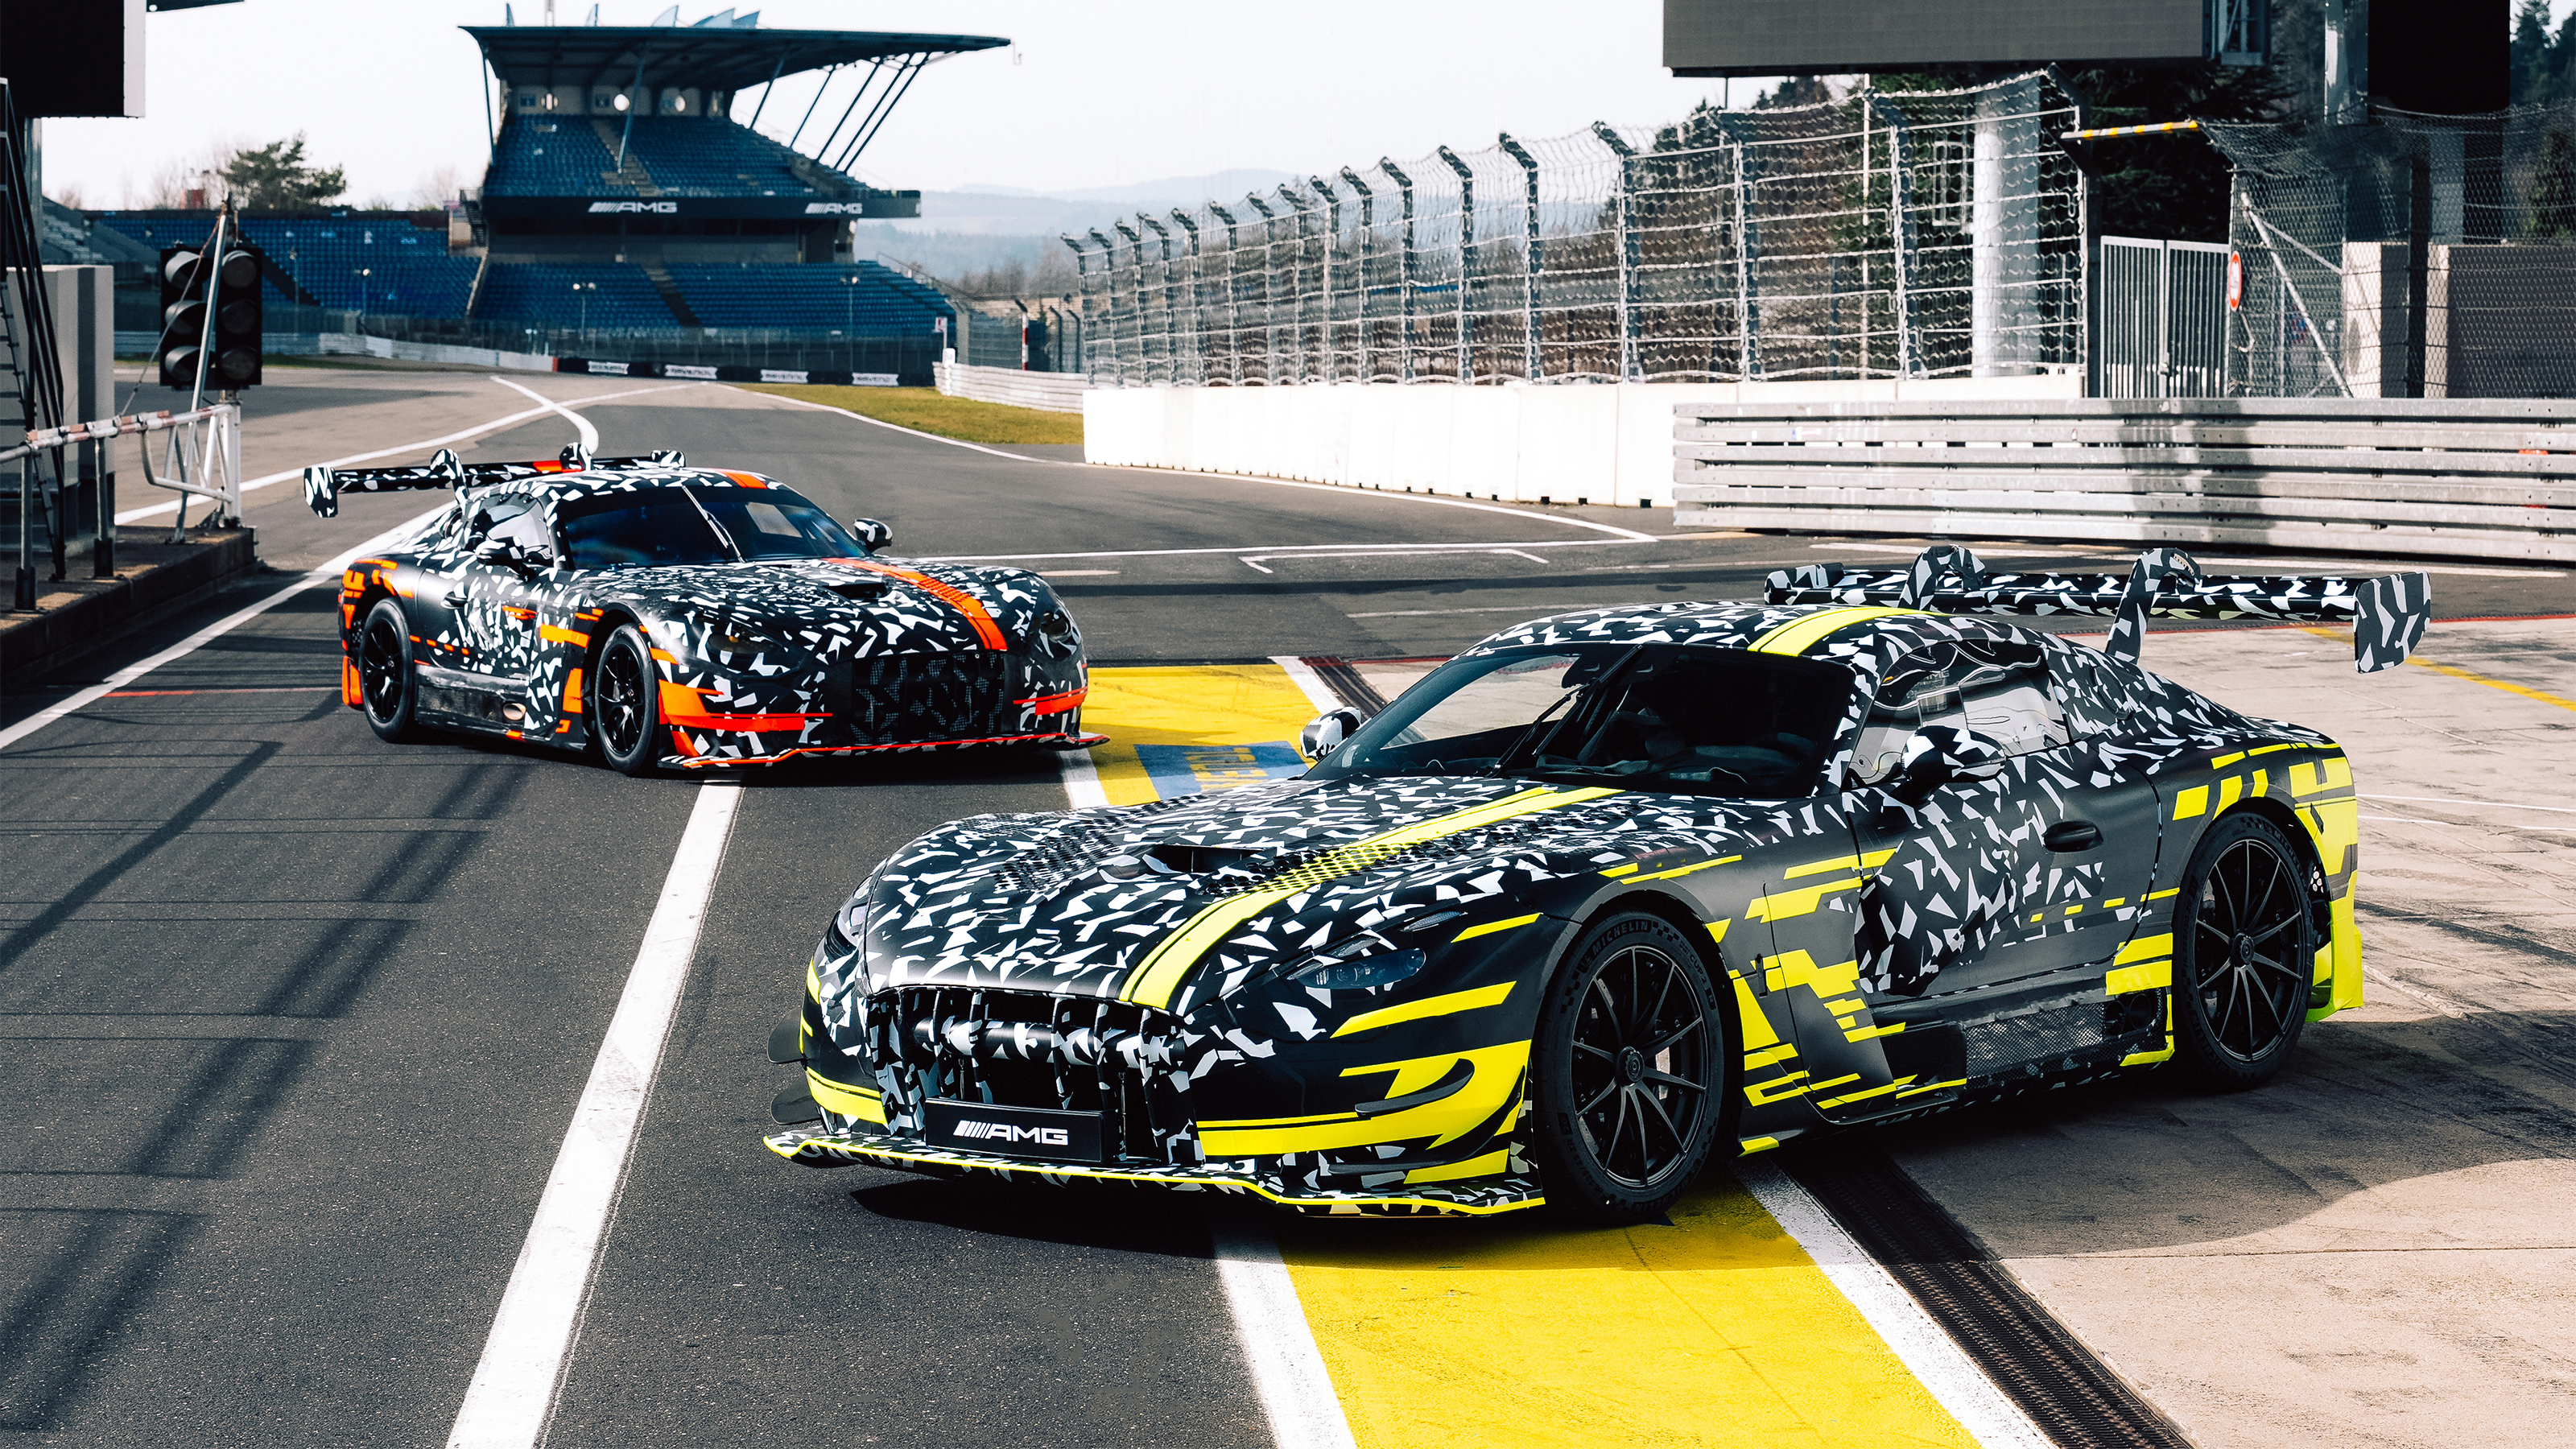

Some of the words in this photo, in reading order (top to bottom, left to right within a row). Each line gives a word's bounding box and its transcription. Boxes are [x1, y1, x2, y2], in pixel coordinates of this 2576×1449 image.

[616, 201, 678, 213] AMG
[824, 203, 863, 214] AMG
[1183, 747, 1269, 790] VENOL
[1592, 921, 1648, 956] MICHELIN
[1690, 954, 1703, 975] CUP
[985, 1124, 1068, 1146] AMG
